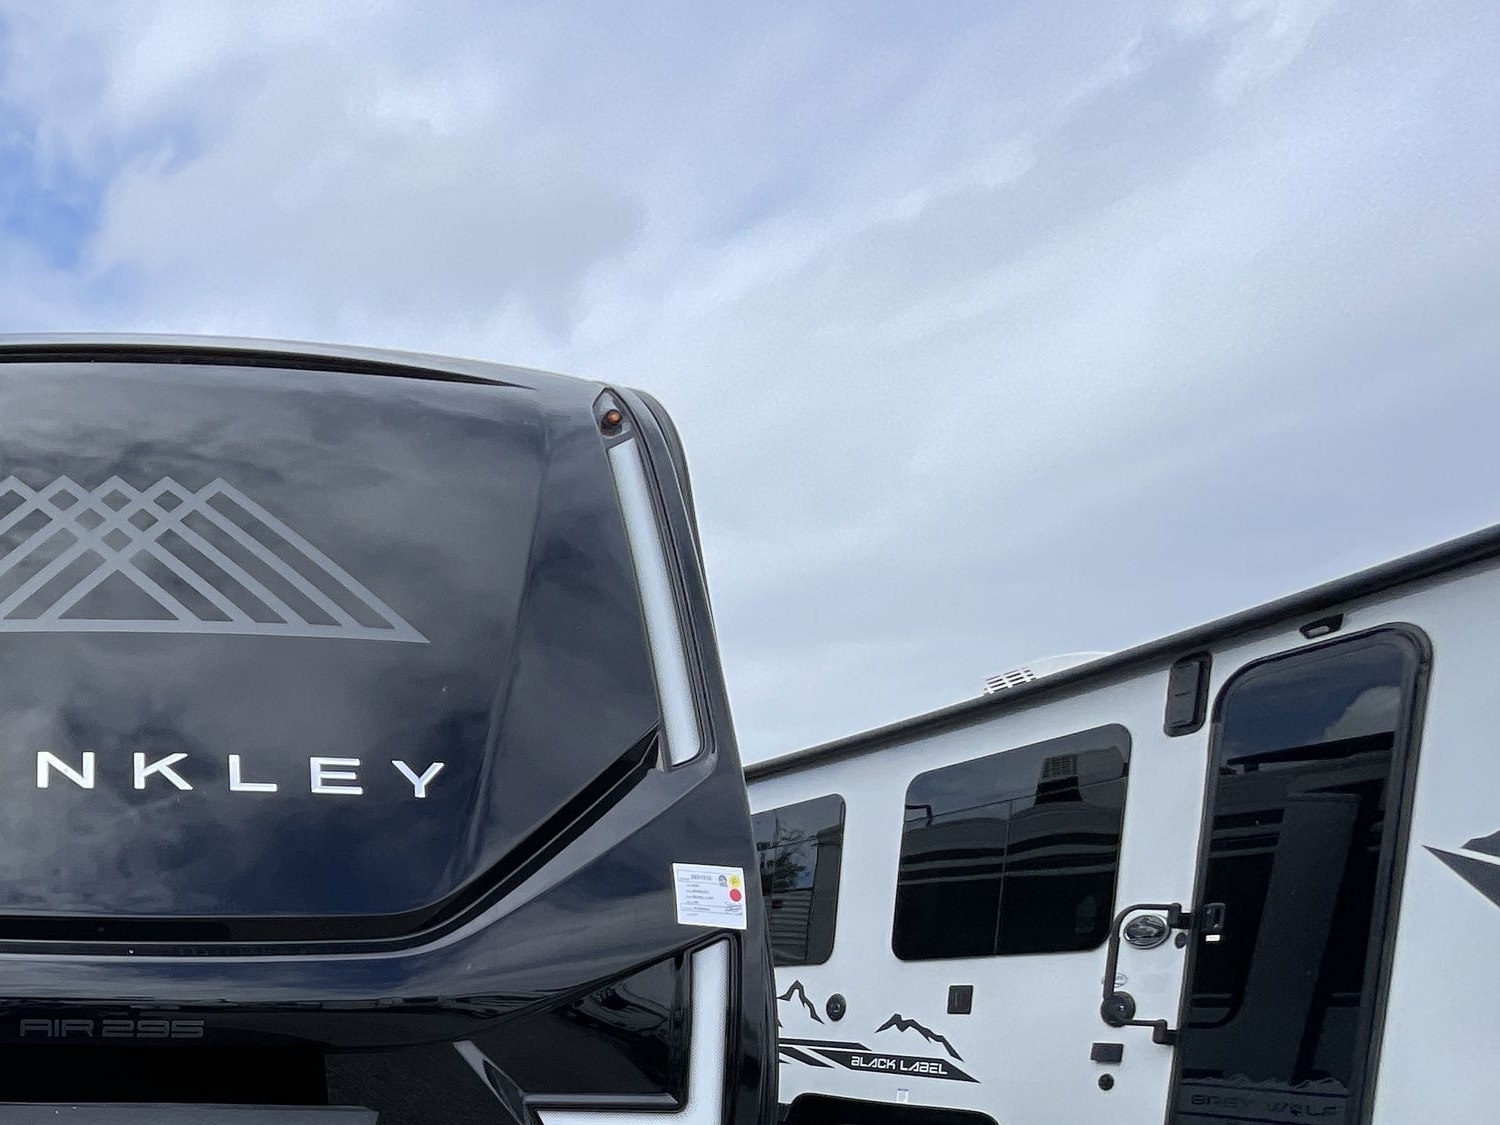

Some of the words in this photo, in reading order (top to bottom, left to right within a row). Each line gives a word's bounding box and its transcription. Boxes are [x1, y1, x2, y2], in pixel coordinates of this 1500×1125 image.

[20, 1018, 94, 1037] AIR
[102, 1019, 205, 1038] 295
[851, 1055, 896, 1070] BLACK
[900, 1060, 948, 1075] LABEL
